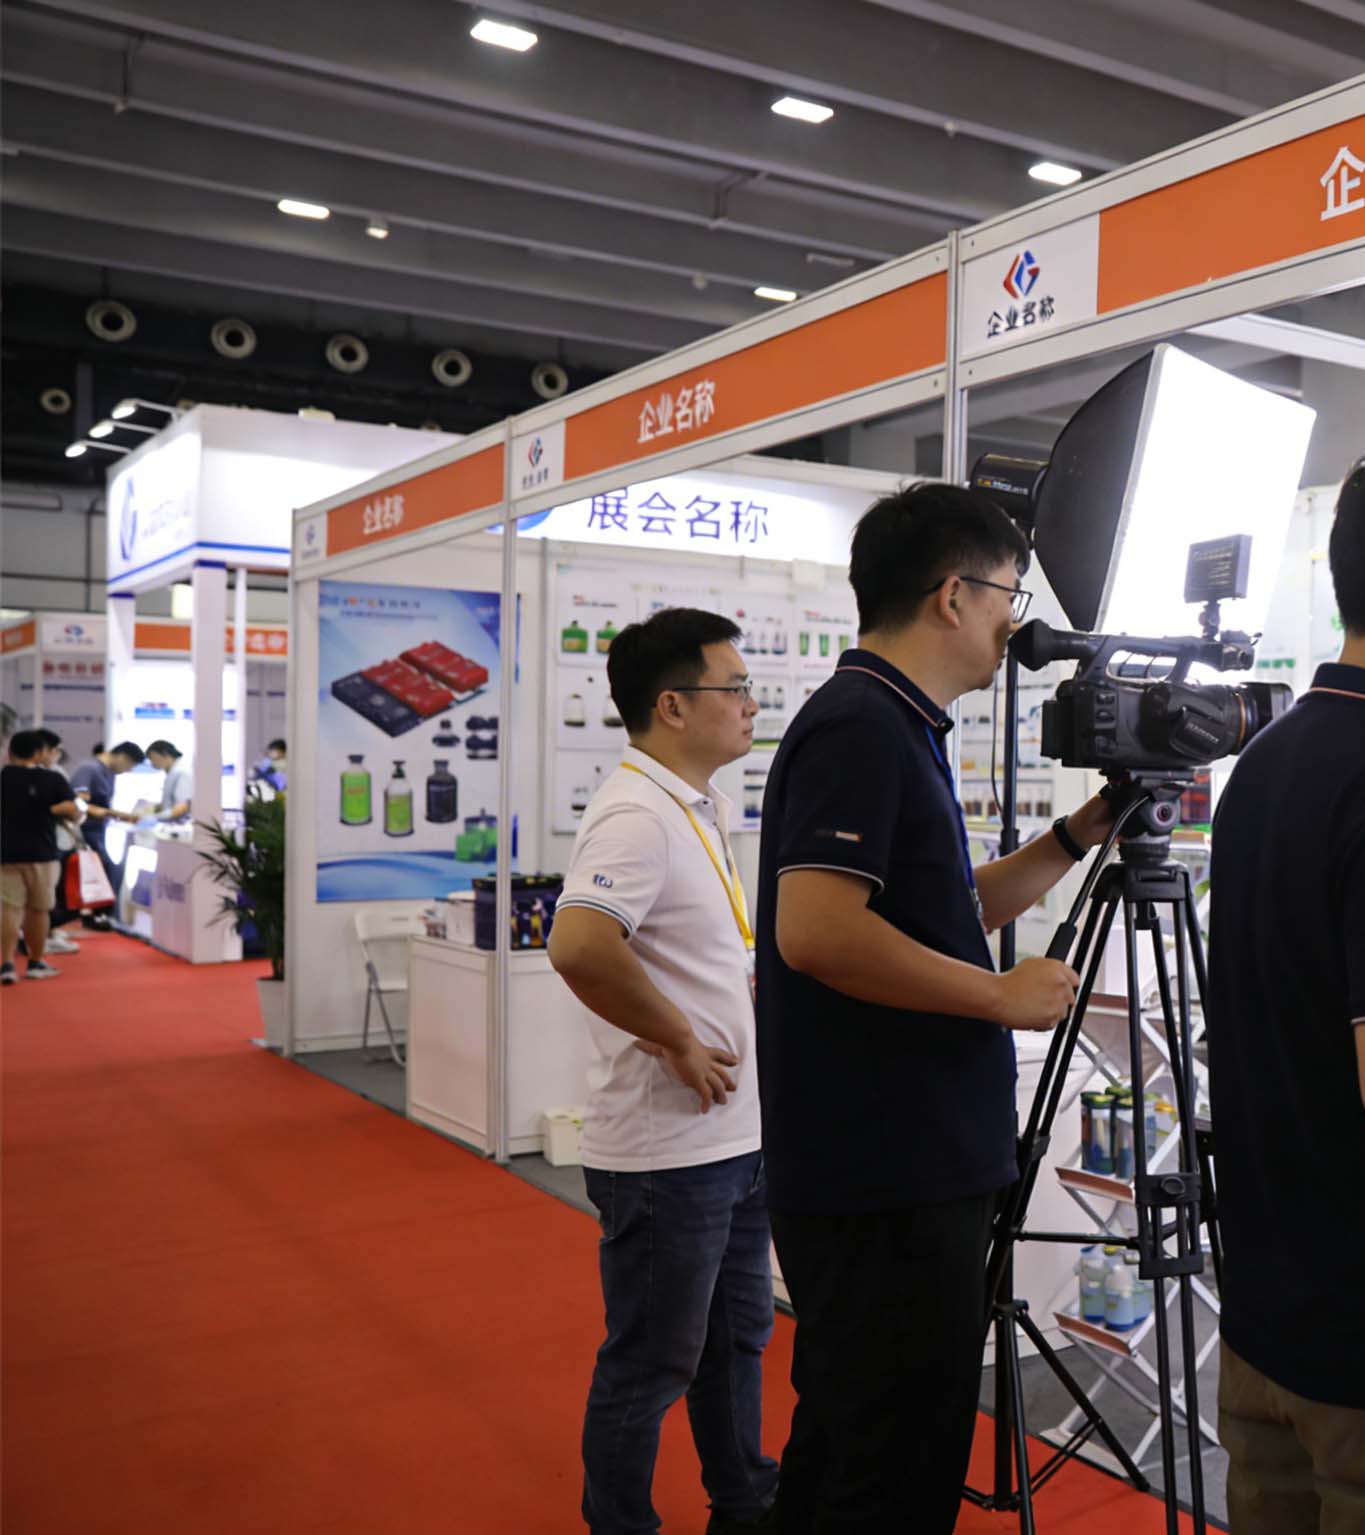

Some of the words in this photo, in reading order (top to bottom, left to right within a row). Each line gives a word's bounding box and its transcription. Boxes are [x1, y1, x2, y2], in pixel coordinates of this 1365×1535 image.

[987, 295, 1055, 339] 企业名称
[637, 379, 717, 444] 企业名称
[587, 486, 769, 544] 展会名称
